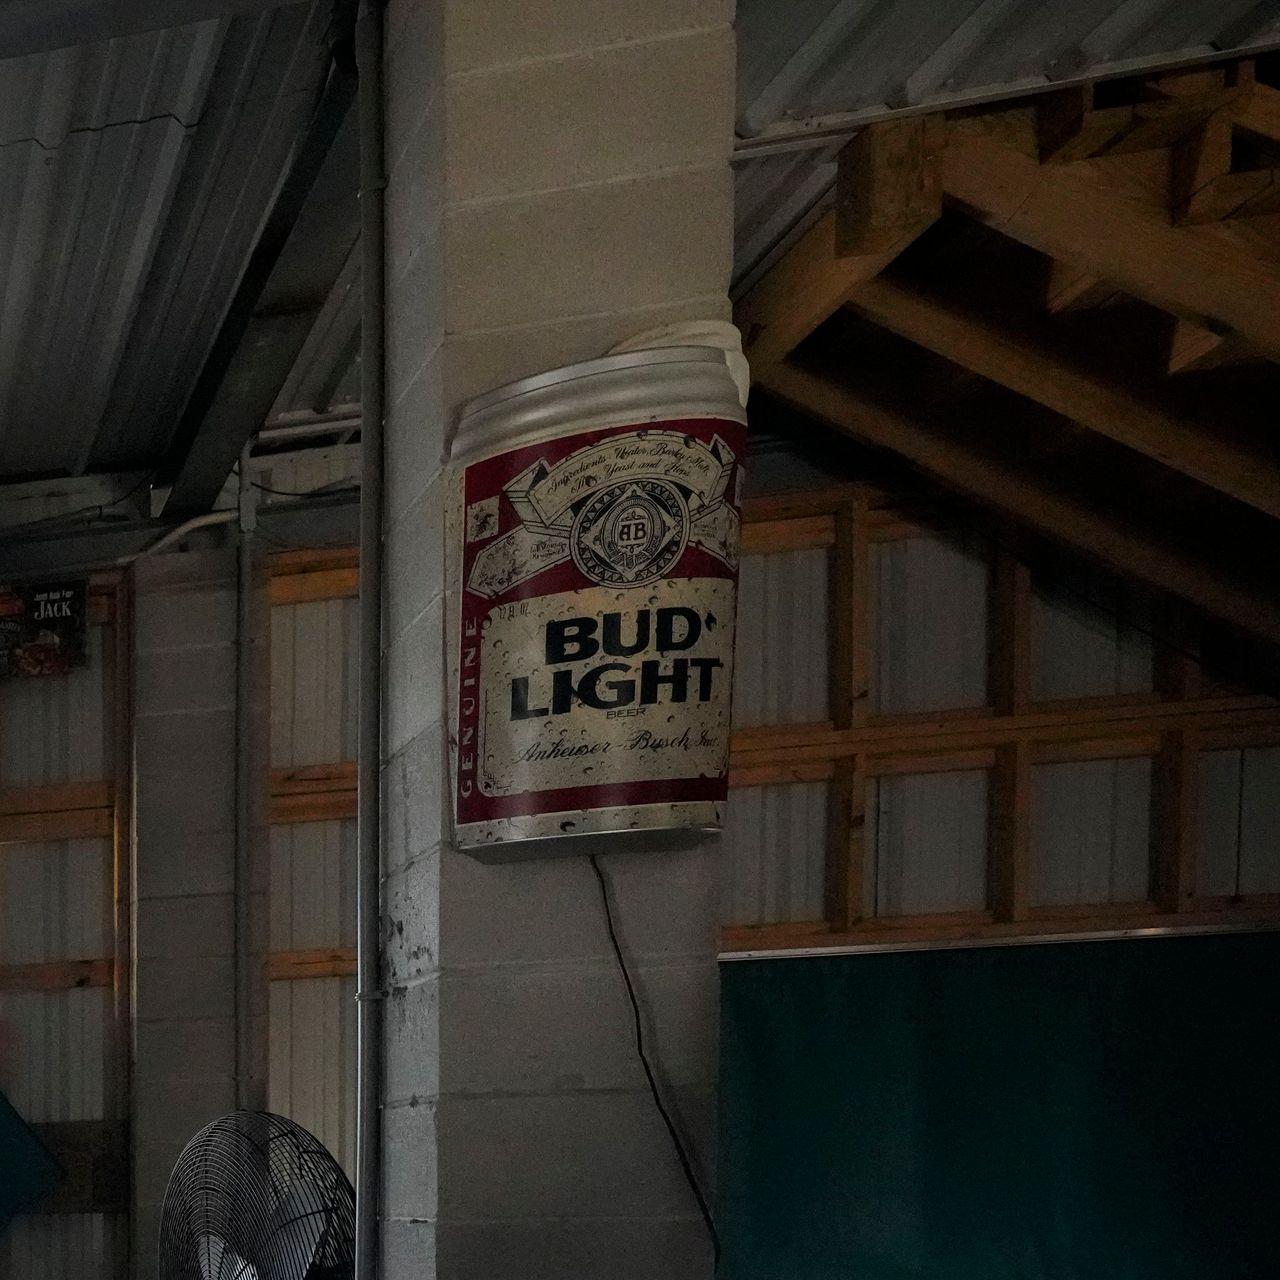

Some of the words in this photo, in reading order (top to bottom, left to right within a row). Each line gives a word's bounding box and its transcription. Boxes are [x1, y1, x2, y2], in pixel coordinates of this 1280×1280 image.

[34, 600, 72, 620] JACK
[546, 607, 702, 665] BUD
[461, 616, 477, 799] GENUINE
[510, 657, 724, 721] LIGHT
[606, 708, 646, 719] BEER
